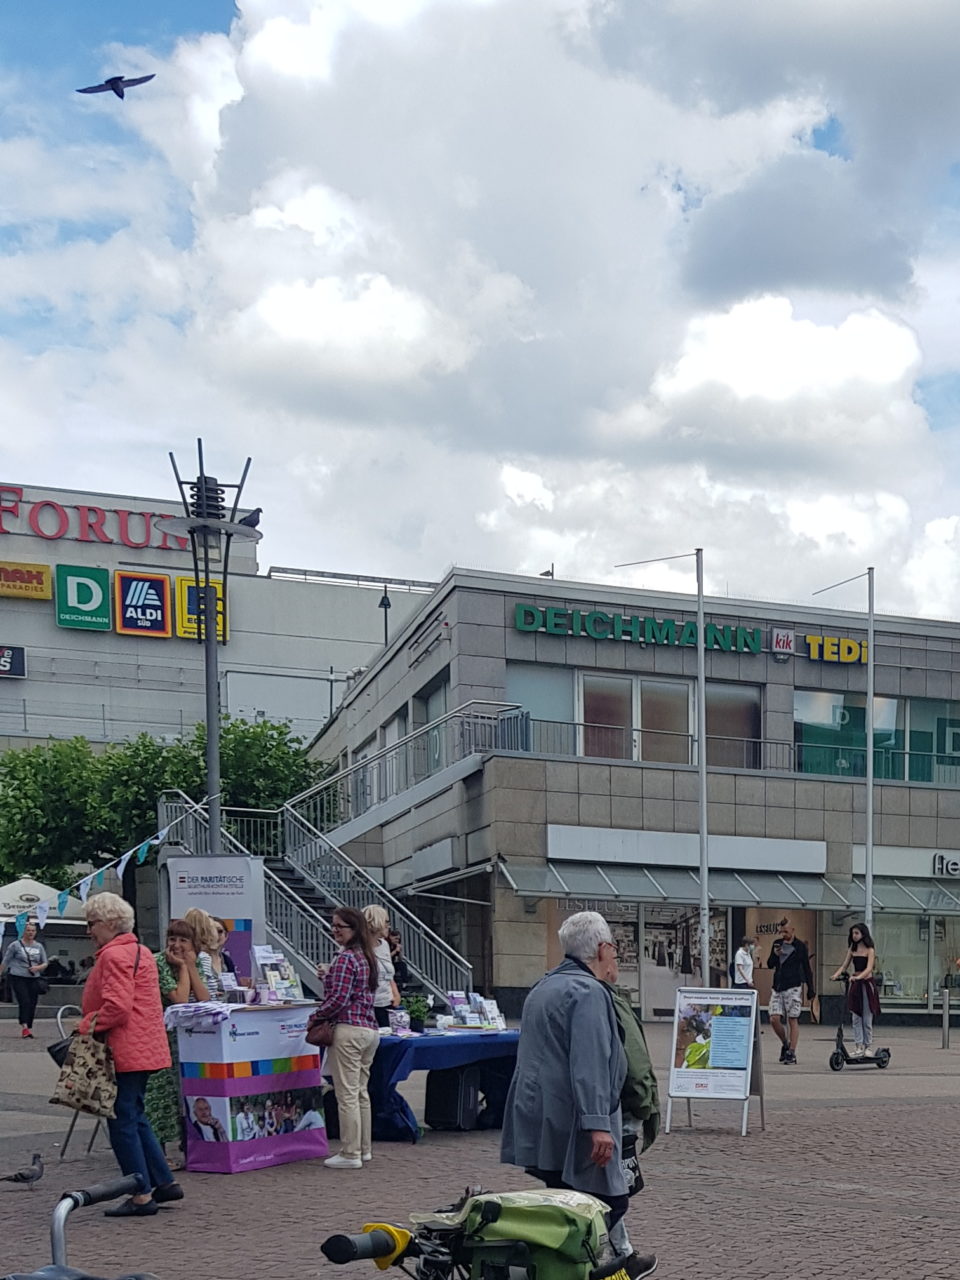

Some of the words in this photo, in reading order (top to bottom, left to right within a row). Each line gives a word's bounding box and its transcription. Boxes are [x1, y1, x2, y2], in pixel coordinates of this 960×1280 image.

[66, 575, 103, 612] D
[60, 612, 109, 624] DEICHMANN
[125, 606, 162, 621] ALDI
[137, 617, 151, 627] SÜD
[514, 602, 762, 654] DEICHMANN
[806, 634, 868, 664] TEDi
